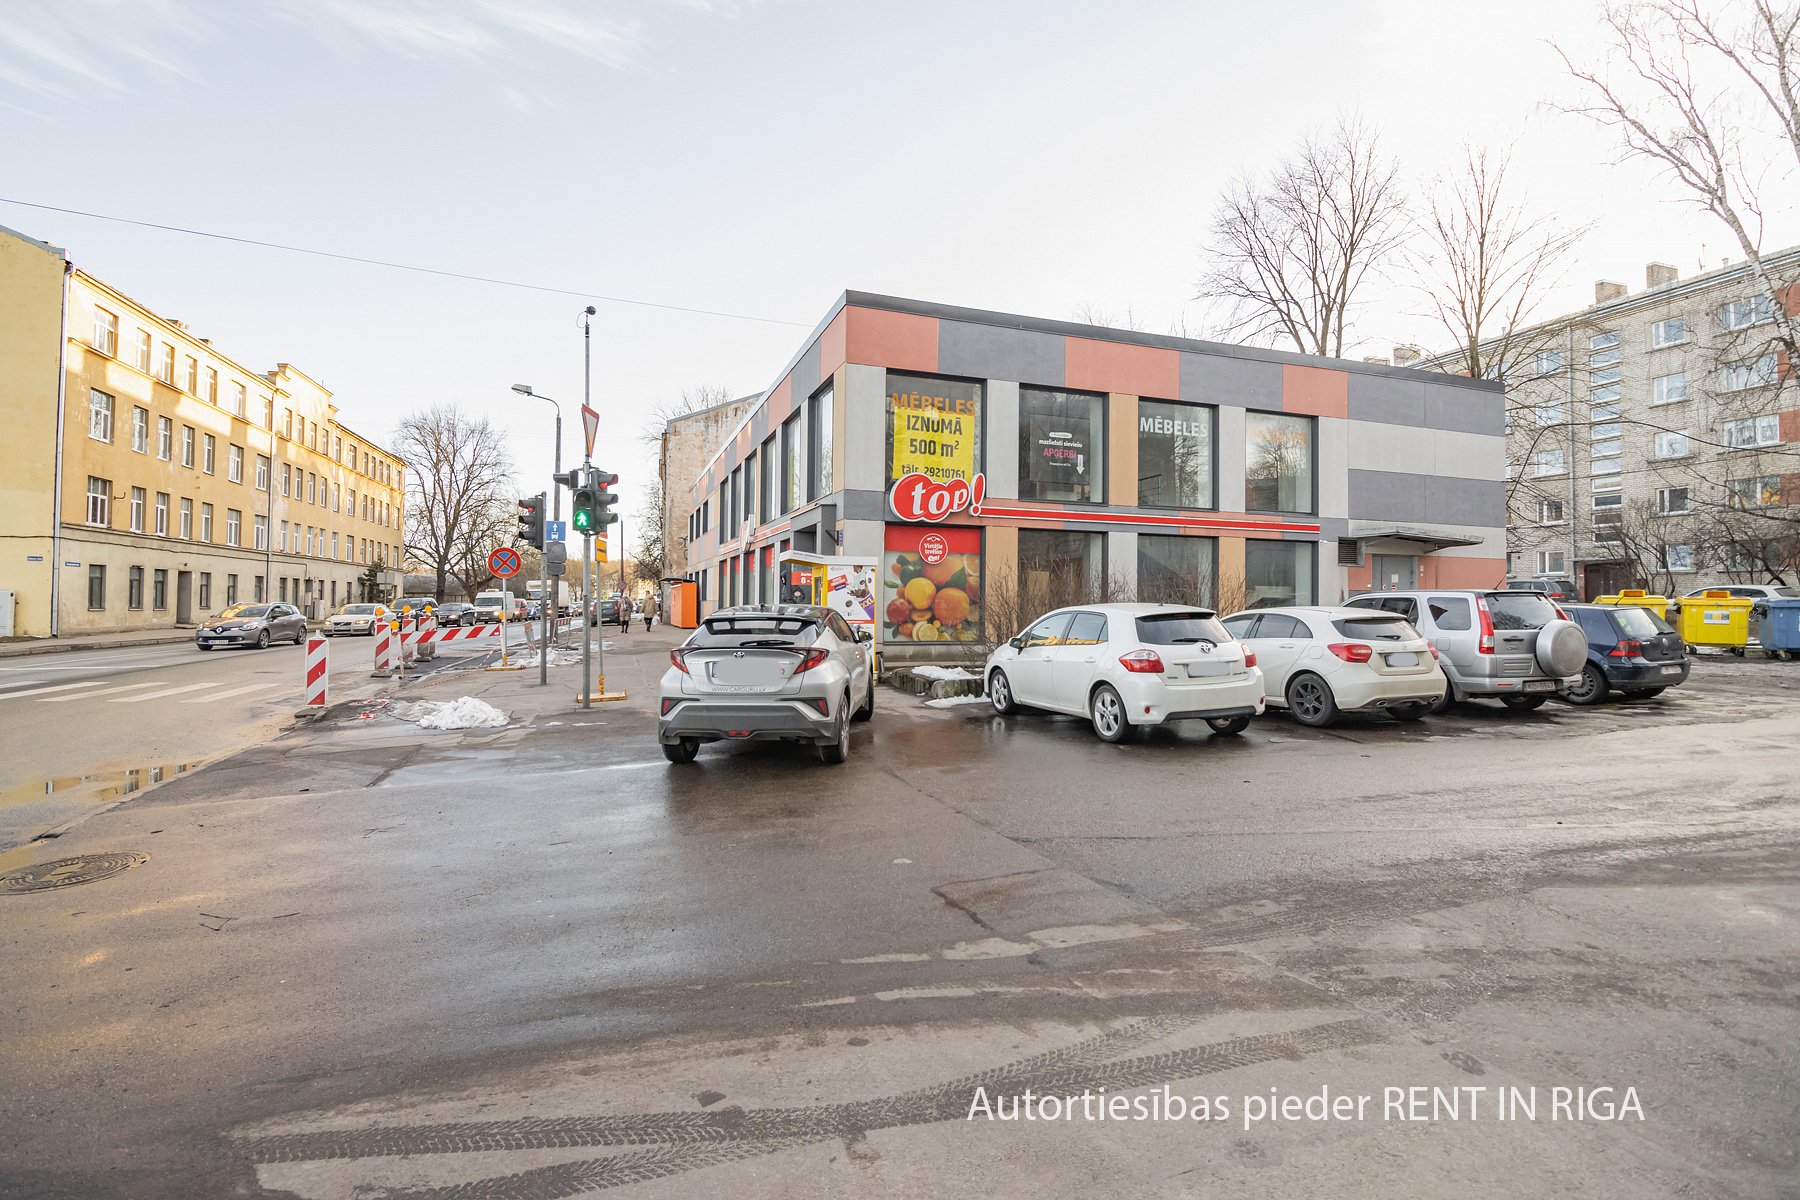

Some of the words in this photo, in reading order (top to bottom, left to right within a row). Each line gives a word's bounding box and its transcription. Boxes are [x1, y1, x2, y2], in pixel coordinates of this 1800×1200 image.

[892, 391, 976, 417] MĒBELES
[1139, 415, 1208, 437] MĒBELES
[1246, 424, 1308, 446] MĒBELES
[909, 438, 936, 456] 500
[1043, 446, 1076, 459] APĢĒRBI
